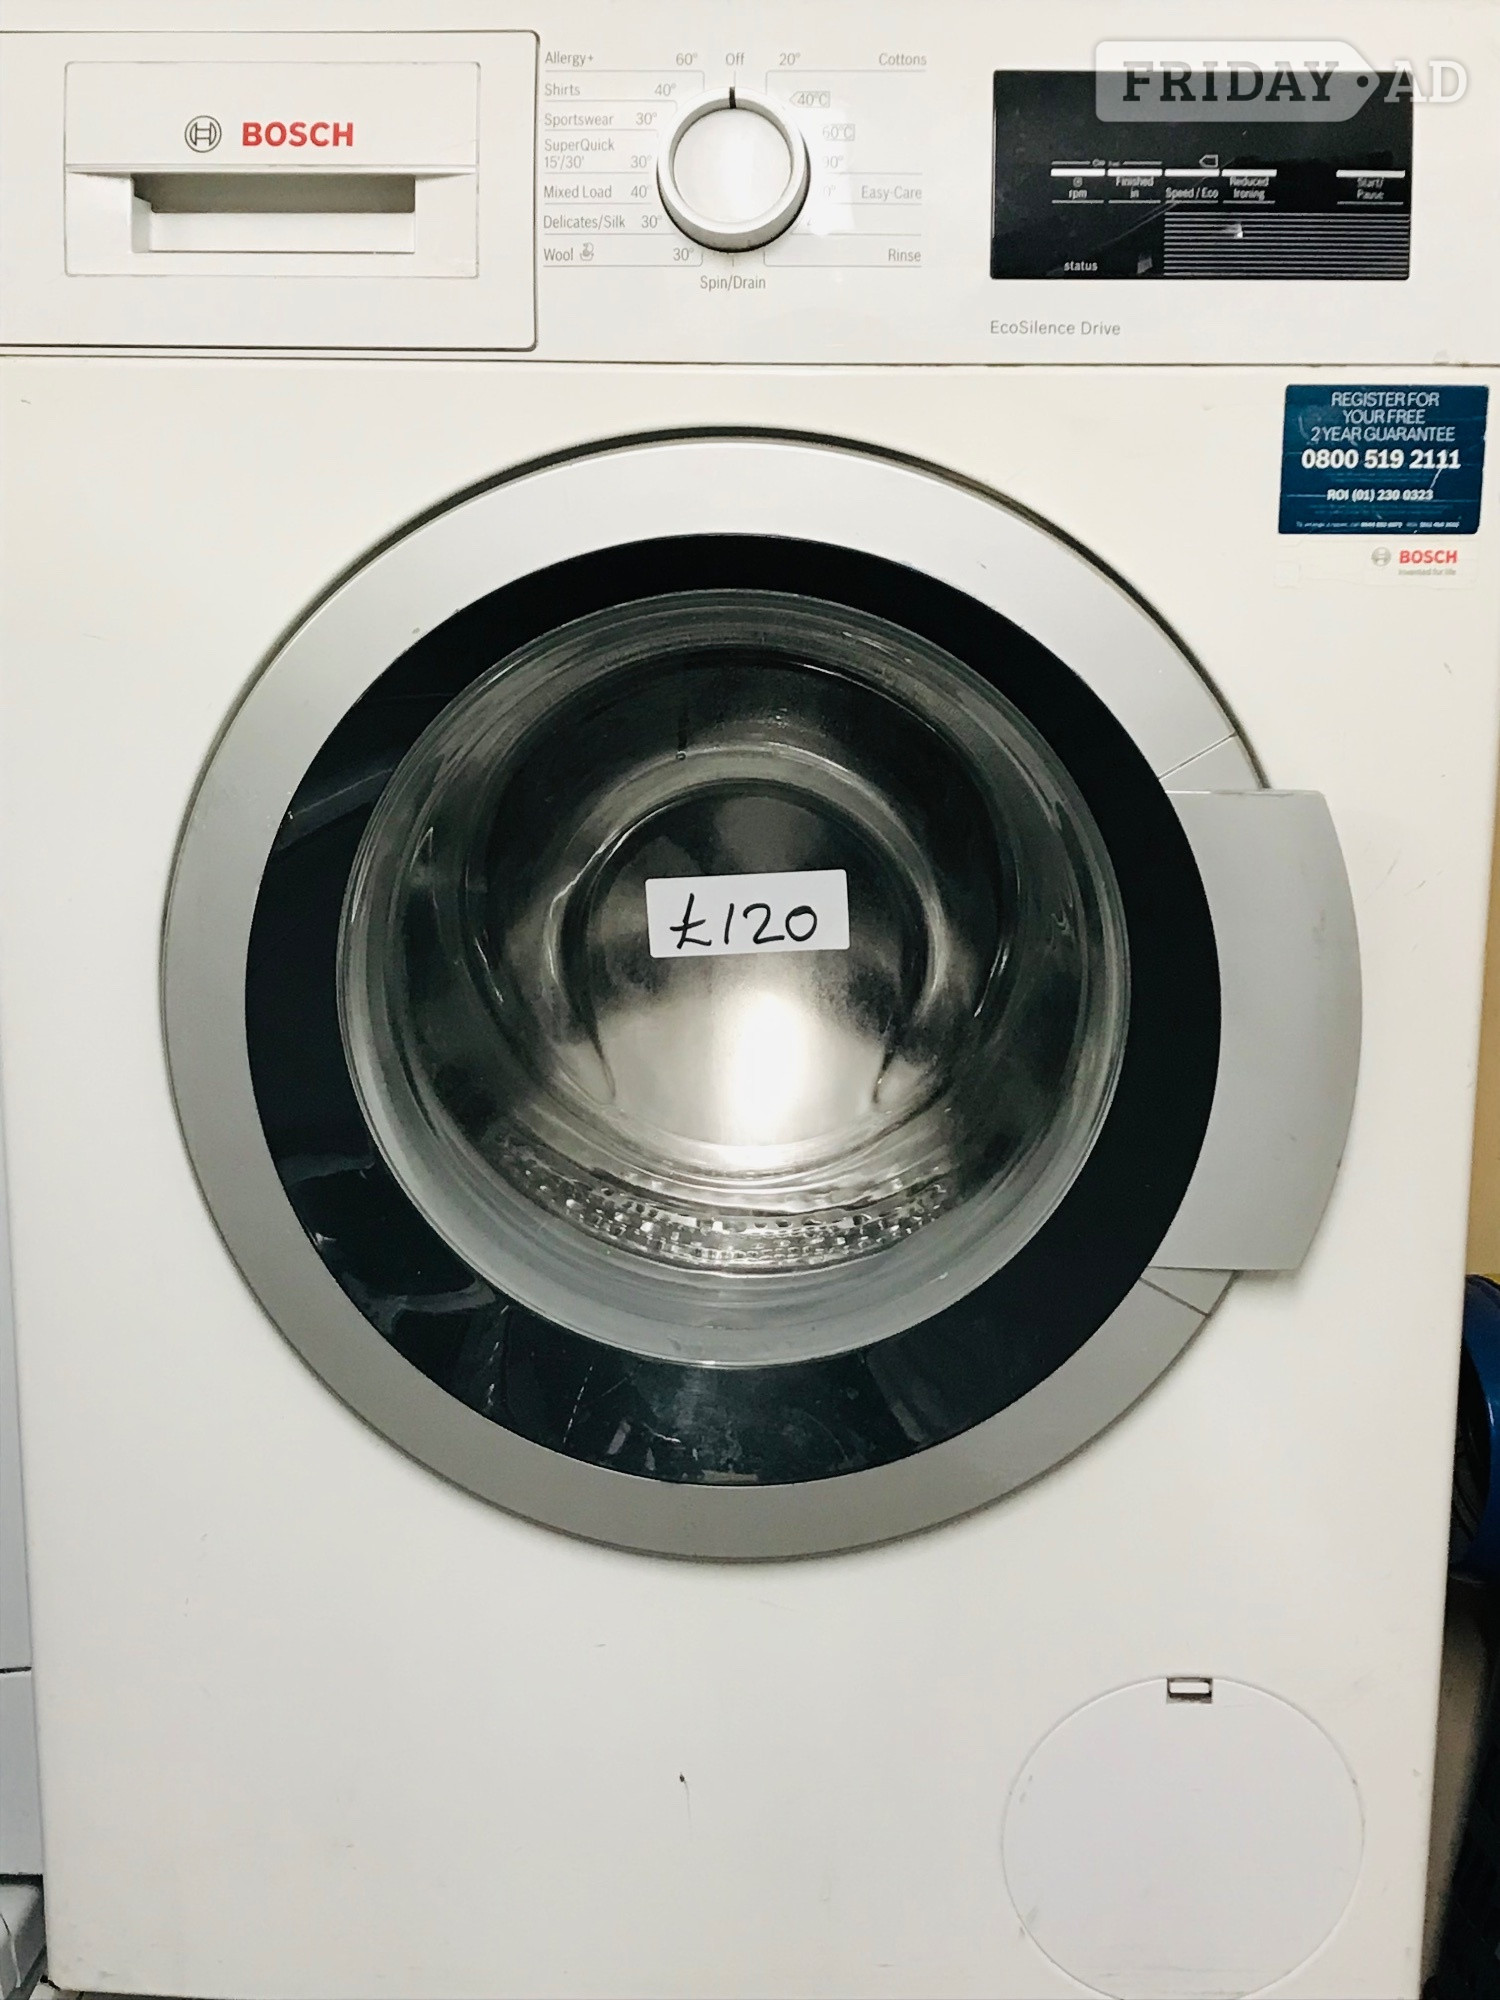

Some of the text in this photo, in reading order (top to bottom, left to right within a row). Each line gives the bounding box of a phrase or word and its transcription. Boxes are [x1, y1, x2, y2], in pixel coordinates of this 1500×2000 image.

[544, 51, 698, 66] Allergy+ 60°
[725, 52, 745, 66] Off
[779, 52, 927, 66] 20° Cottons
[544, 83, 677, 97] Shirts 40°
[544, 112, 658, 128] Sportswear 30°
[242, 121, 354, 147] BOSCH
[544, 138, 615, 153] SuperQuick
[543, 184, 580, 199] Mixed
[582, 185, 613, 199] Load
[893, 185, 923, 199] Care
[543, 214, 626, 230] Delicates/Silk
[543, 246, 695, 262] Wool 30°
[888, 248, 922, 263] Rinse
[1063, 260, 1098, 272] status
[699, 274, 767, 290] Spin/Drain
[990, 319, 1122, 336] EcoSilence Drive
[1331, 391, 1441, 407] REGISTER FOR
[1343, 408, 1426, 425] YOUR FREE
[1310, 426, 1456, 443] 2 YEAR GUARANTEE
[1301, 448, 1462, 470] 0800 519 2111
[1326, 488, 1350, 501] ROI
[1376, 488, 1401, 501] 230
[1399, 549, 1458, 564] BOSCH
[669, 892, 818, 950] £120
